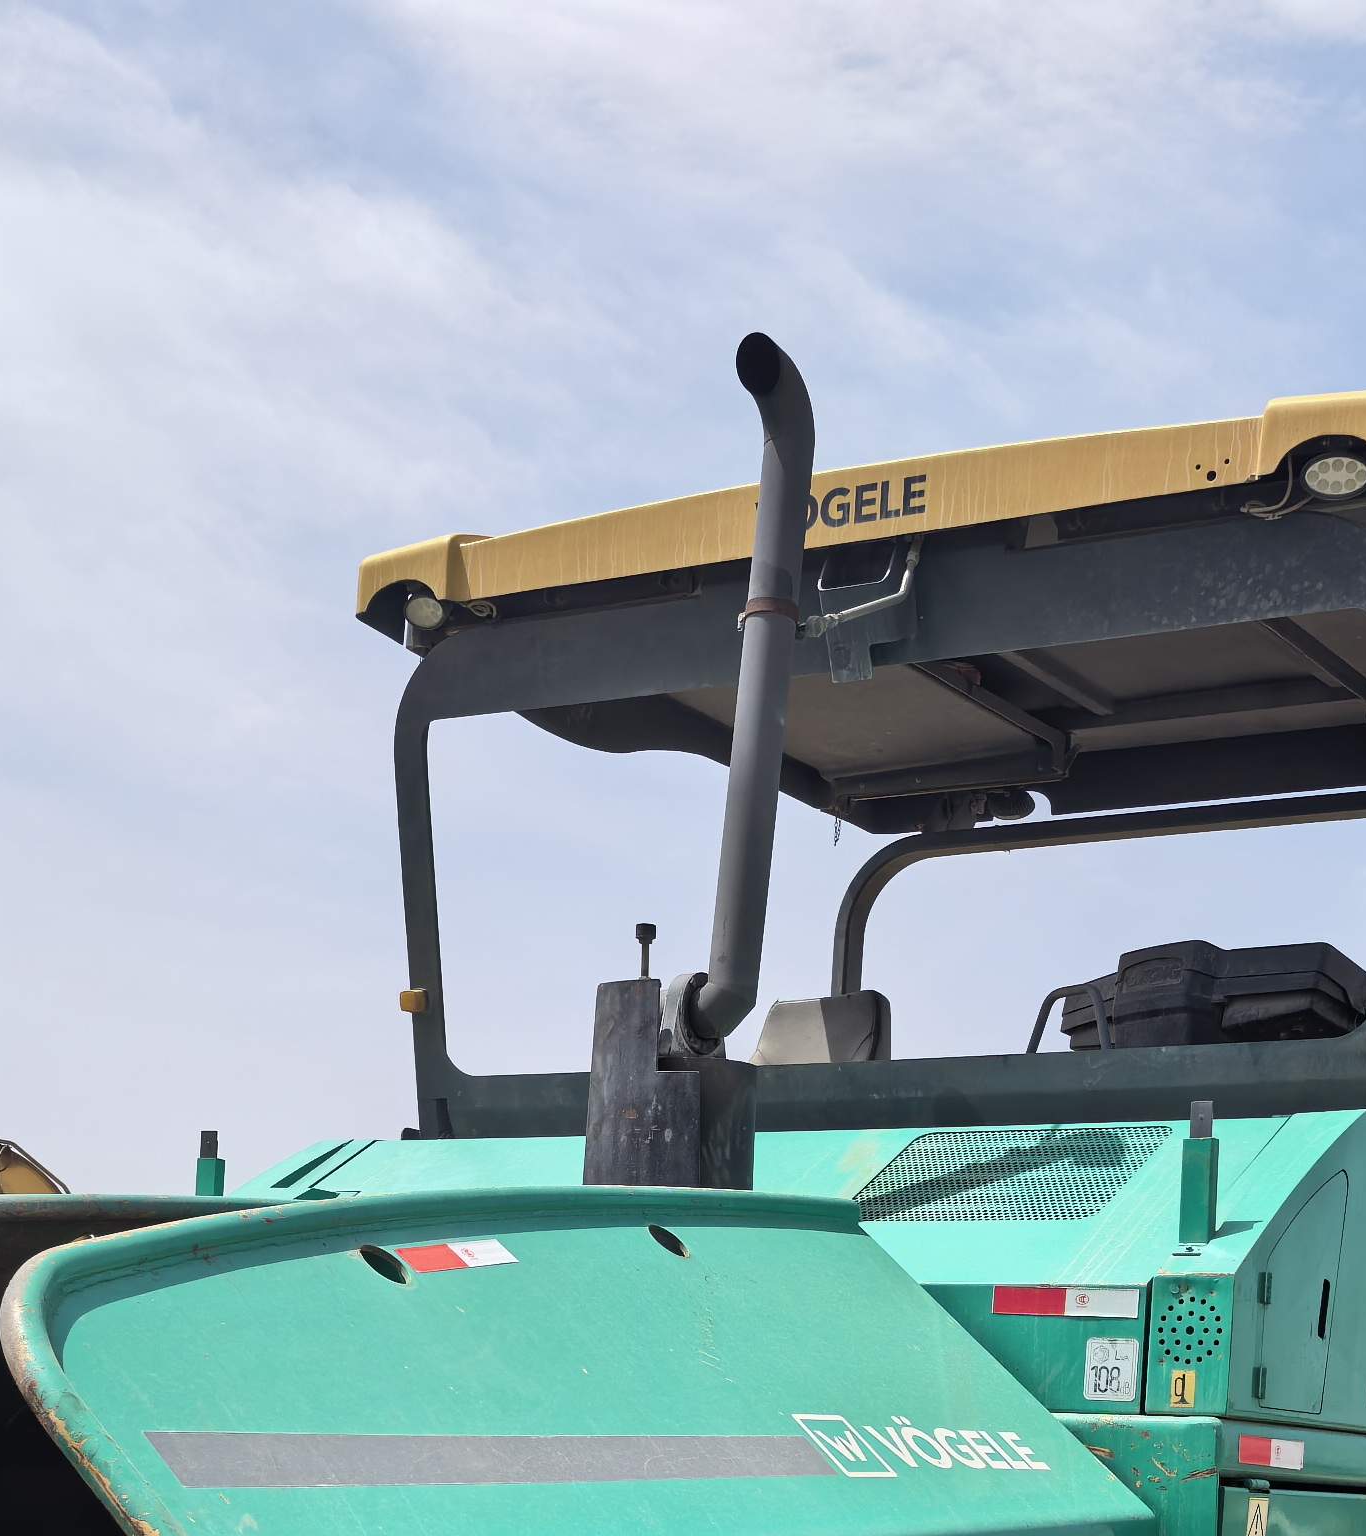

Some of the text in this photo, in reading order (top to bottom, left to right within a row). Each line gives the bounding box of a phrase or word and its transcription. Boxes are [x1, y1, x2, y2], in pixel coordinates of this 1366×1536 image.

[755, 475, 927, 530] GELE
[1091, 1366, 1120, 1393] 108
[863, 1416, 1052, 1471] VÖGELE
